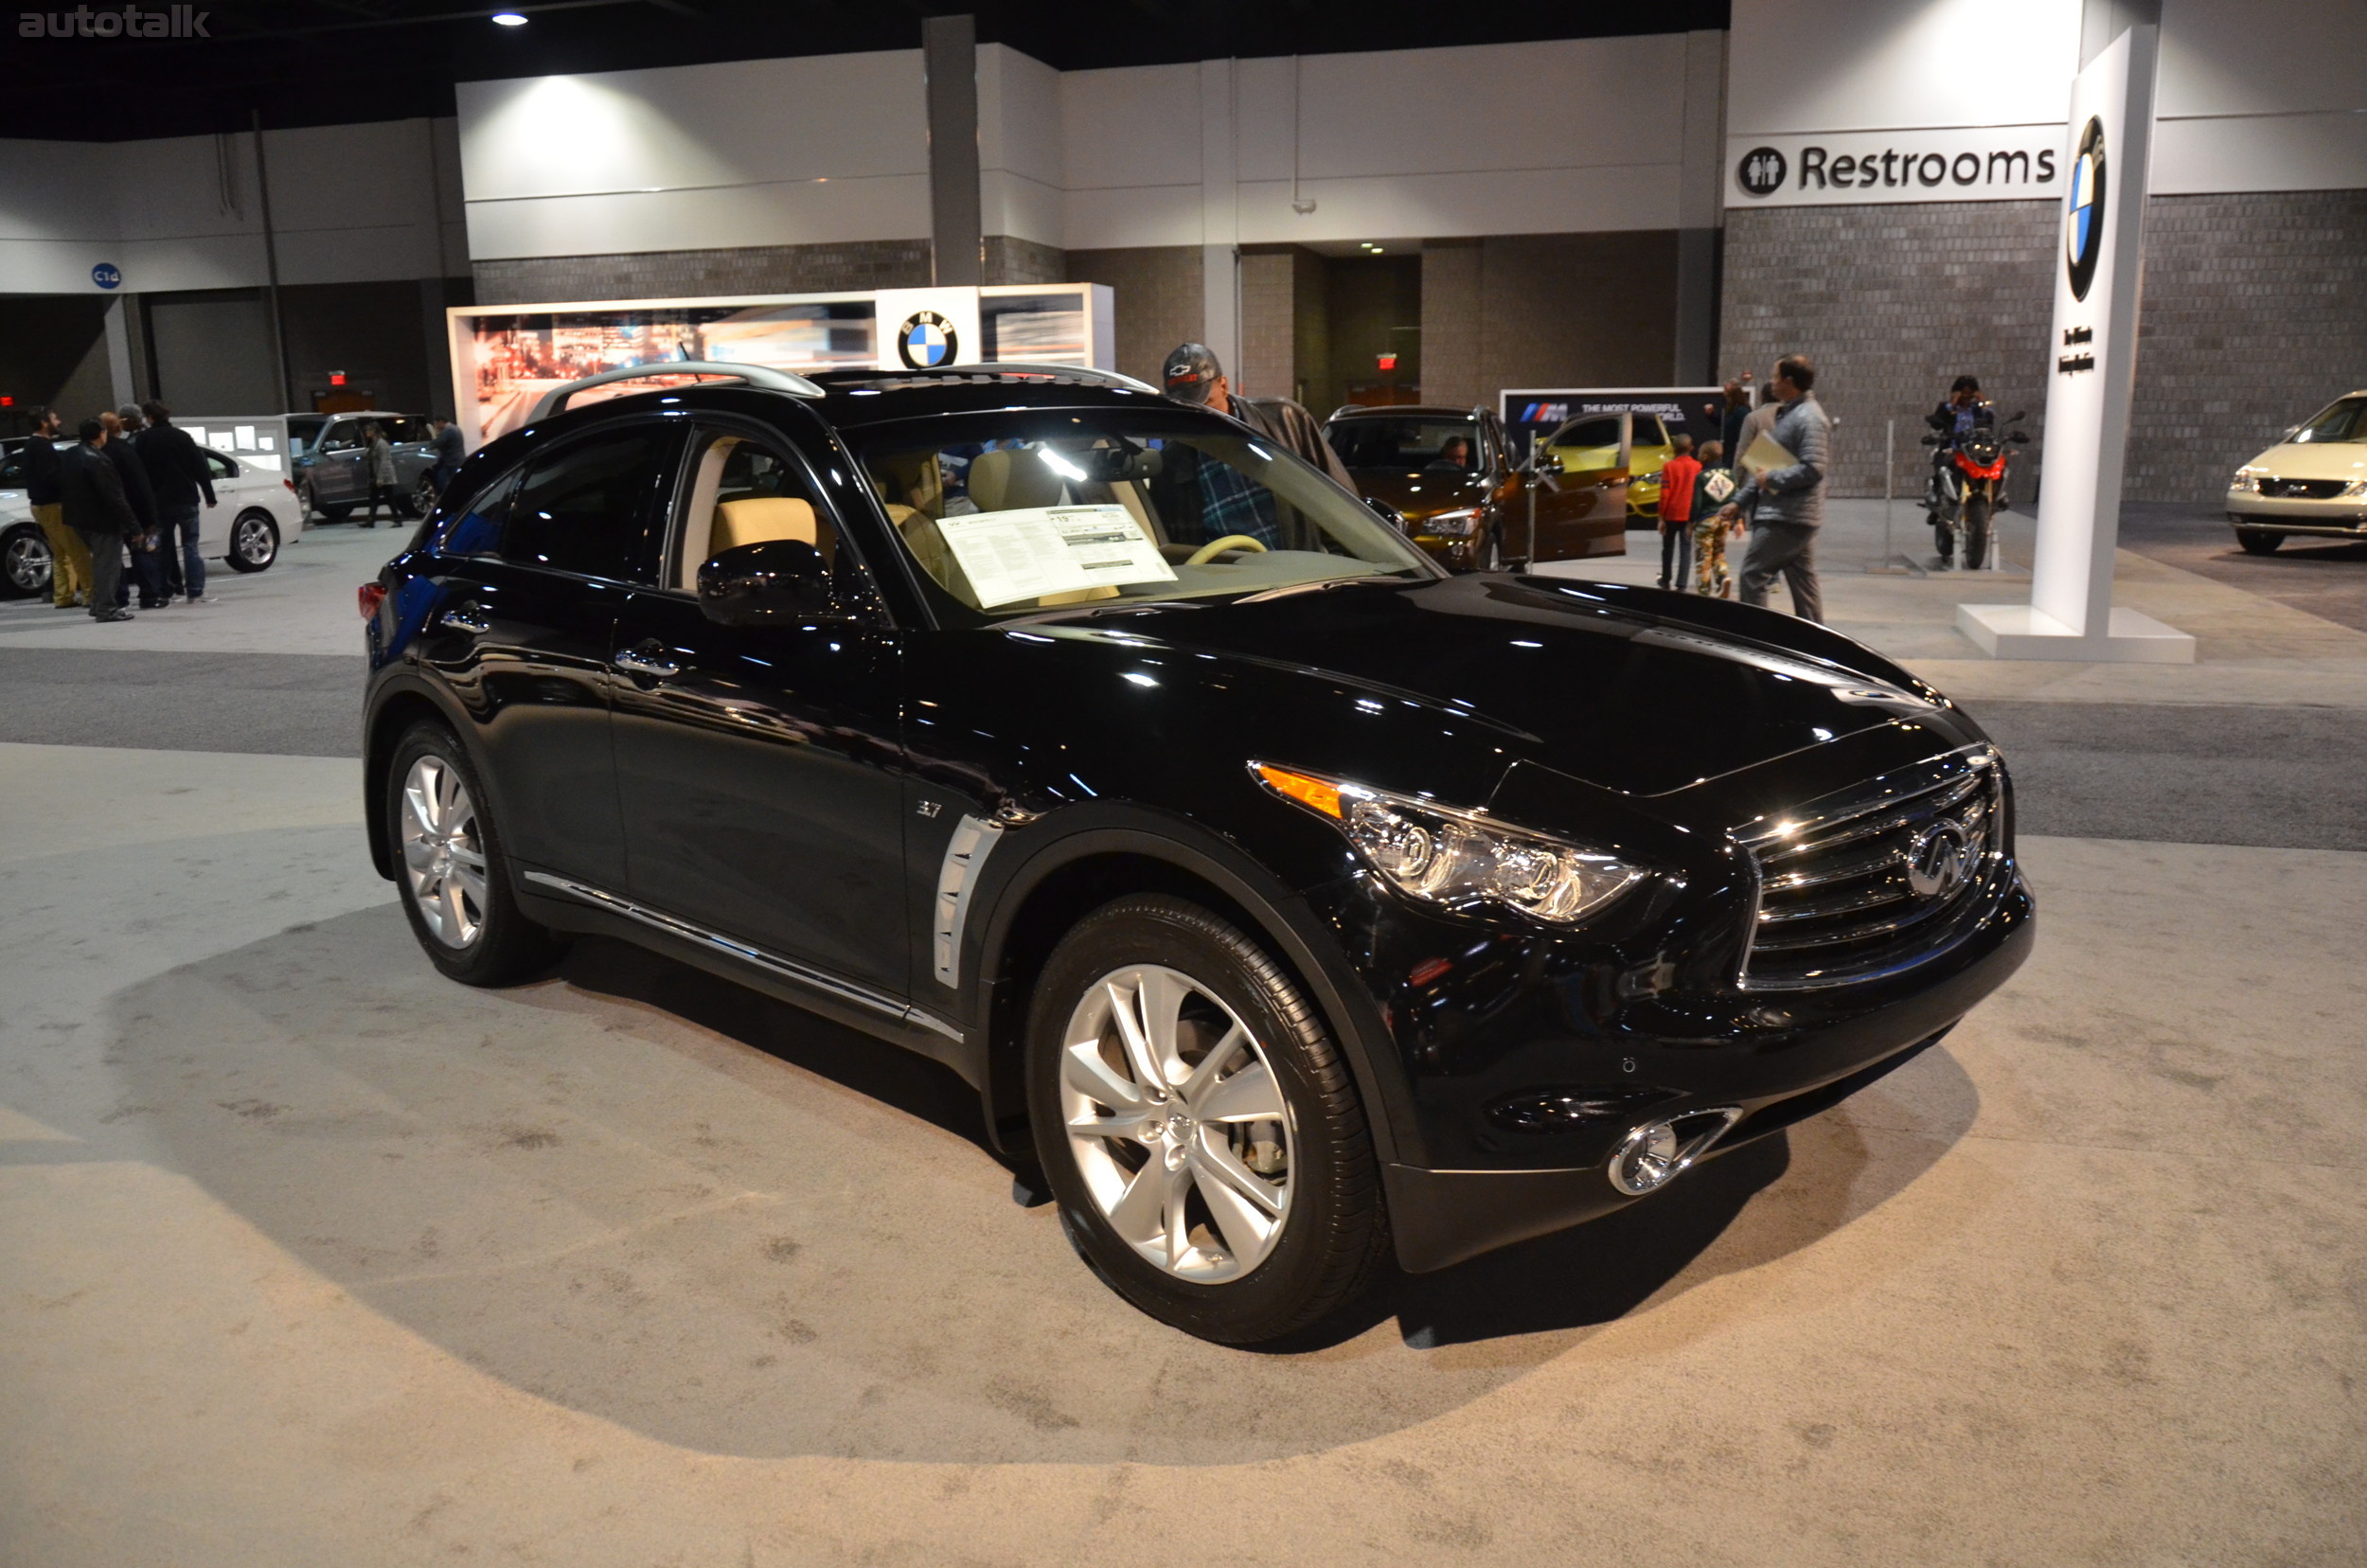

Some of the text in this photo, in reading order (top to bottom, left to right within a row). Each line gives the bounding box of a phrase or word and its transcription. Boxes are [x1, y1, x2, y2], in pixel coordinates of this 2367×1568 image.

[1799, 146, 2056, 189] Restrooms
[900, 311, 953, 335] BMW
[1582, 403, 1601, 413] THE
[1602, 403, 1629, 413] MOST
[1630, 402, 1682, 413] POWERFUL
[1657, 412, 1686, 421] ORLD.
